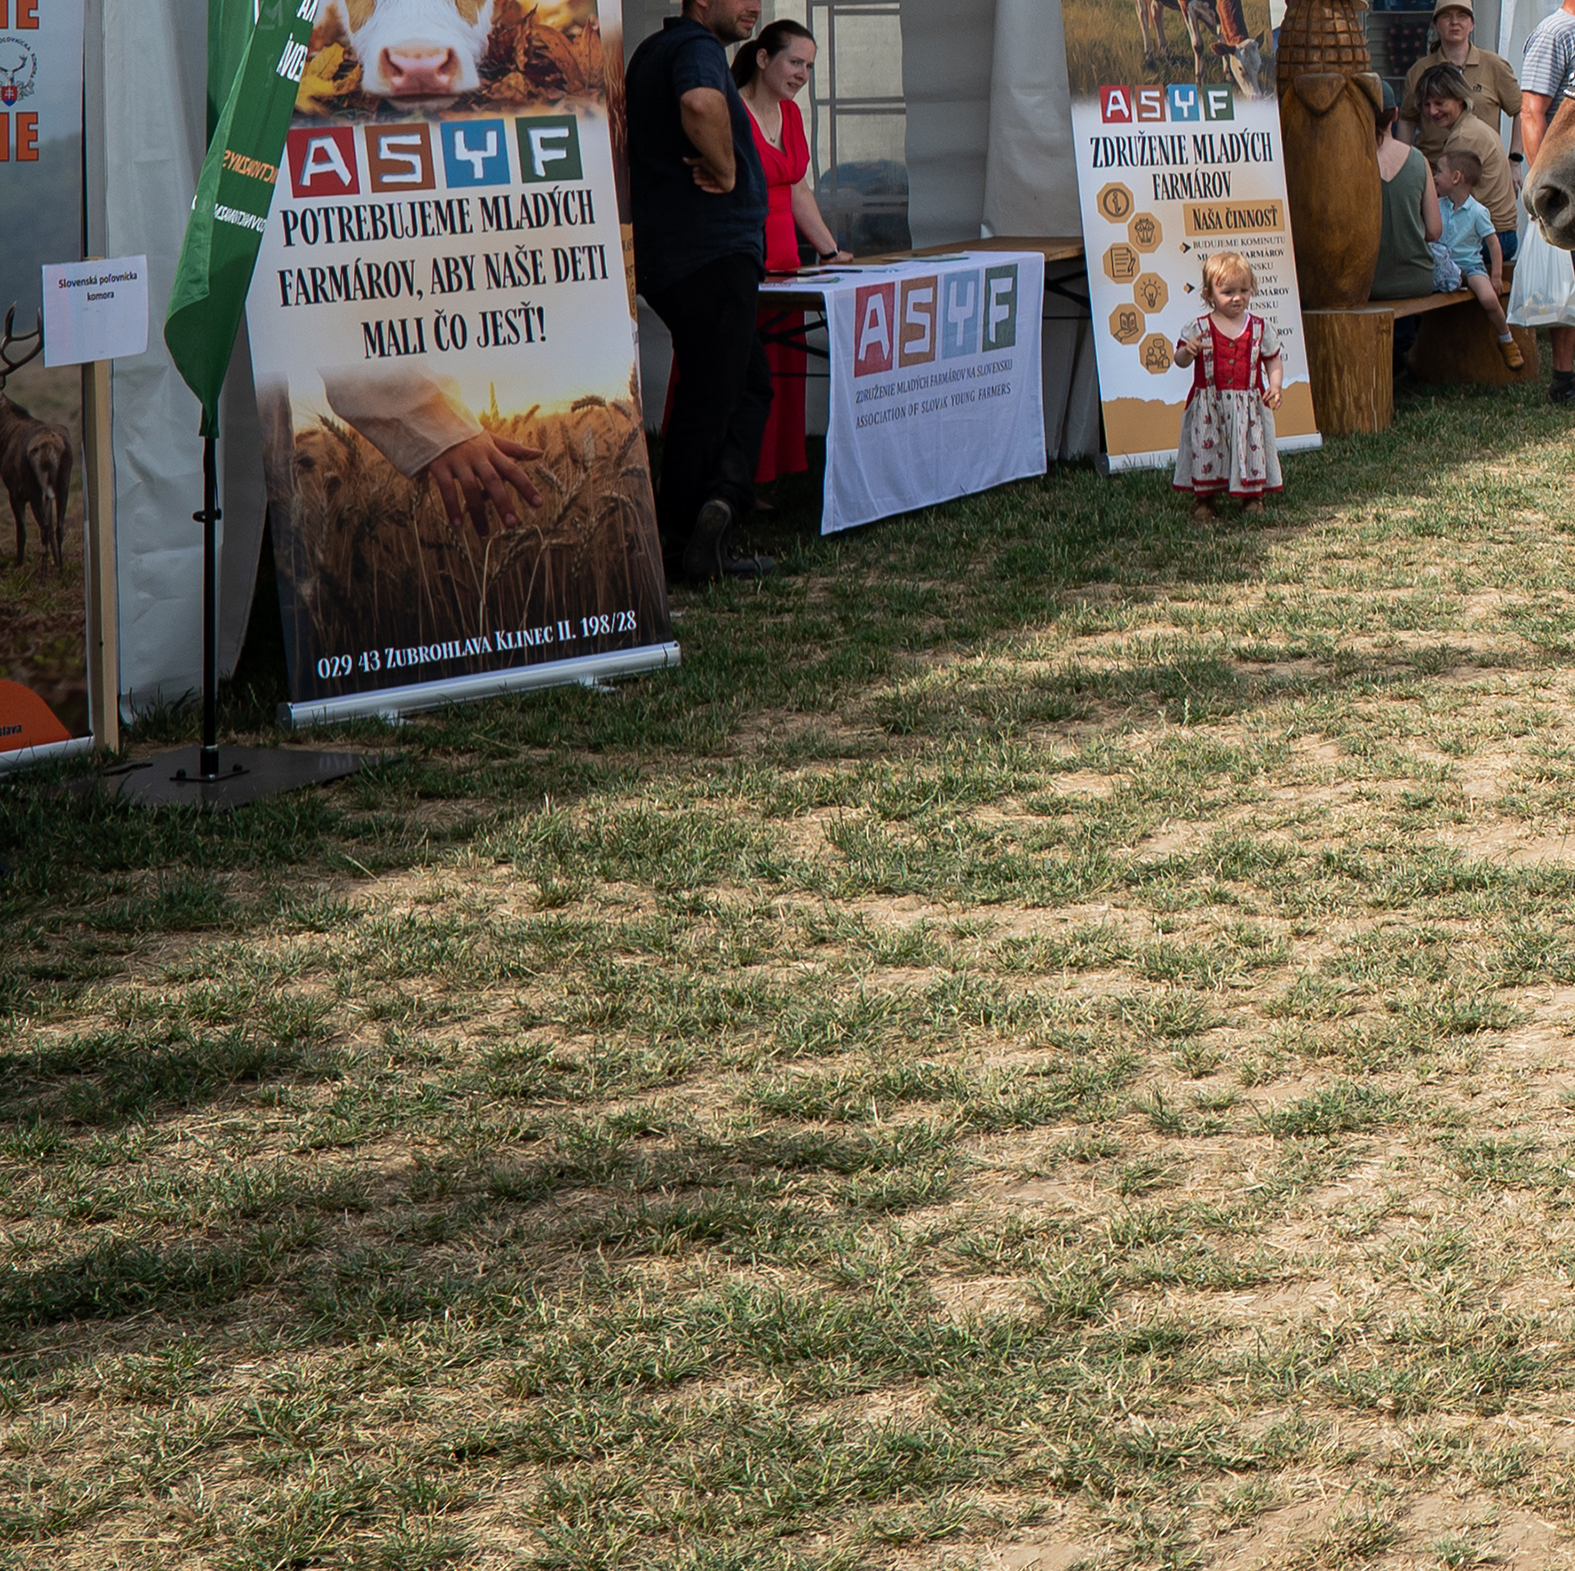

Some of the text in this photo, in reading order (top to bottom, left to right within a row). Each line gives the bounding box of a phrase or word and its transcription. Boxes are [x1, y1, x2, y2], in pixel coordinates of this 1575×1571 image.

[1102, 86, 1232, 121] ASYF
[295, 122, 575, 191] ASYF
[1089, 127, 1274, 169] ZDRUŽENIE MLADÝCH
[1152, 167, 1232, 201] FARMÁROV
[279, 196, 474, 248] POTREBUJEME
[477, 185, 597, 234] MLADÝCH
[1225, 204, 1278, 229] ČINNOSŤ
[1192, 239, 1240, 249] BUDUJEME
[86, 291, 115, 301] komora
[276, 257, 424, 308] FARMÁROV,
[429, 254, 477, 296] ABY
[484, 244, 547, 290] NAŠE
[551, 244, 609, 284] DETI
[360, 301, 547, 359] MALI ČO JESŤ!
[856, 271, 1016, 369] ASYF
[855, 382, 896, 405] ZDRUŽENIE
[896, 374, 930, 396] MLADÝCH
[930, 367, 967, 388] FARMÁROV
[855, 382, 1011, 429] ASSOCIATION OF SLOVAK YOUNG FARMERS
[317, 654, 353, 679] 029
[357, 650, 382, 672] 43
[580, 610, 637, 637] 198/28
